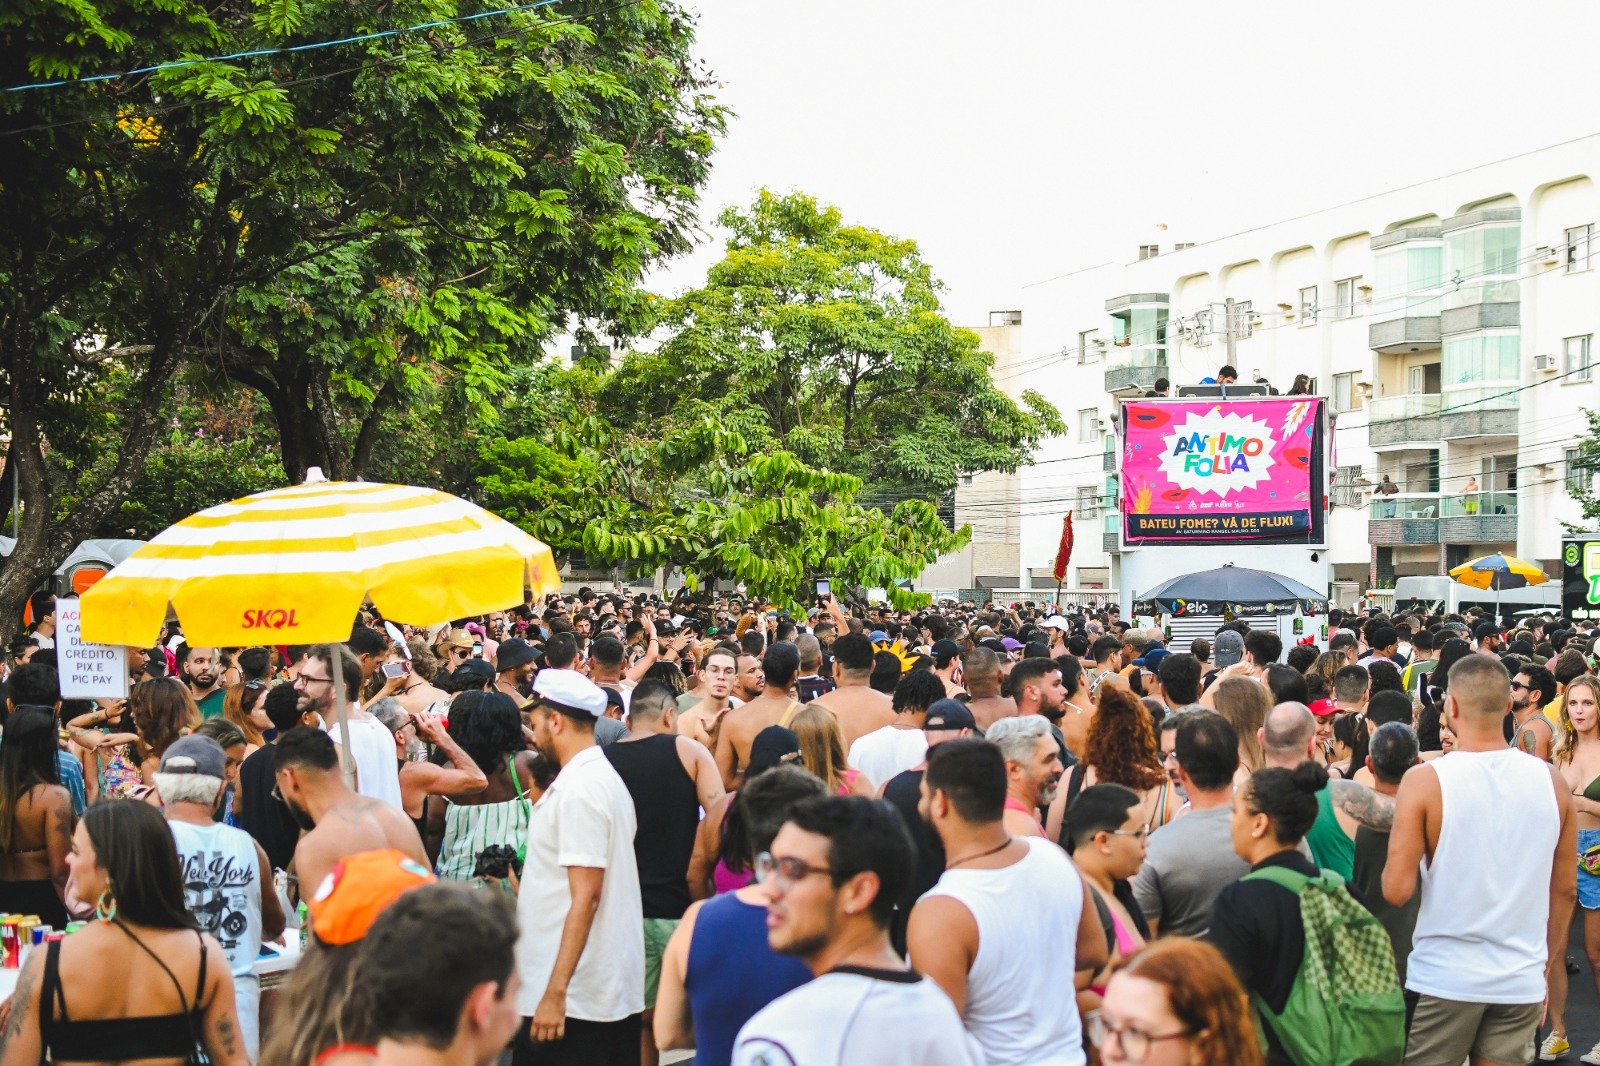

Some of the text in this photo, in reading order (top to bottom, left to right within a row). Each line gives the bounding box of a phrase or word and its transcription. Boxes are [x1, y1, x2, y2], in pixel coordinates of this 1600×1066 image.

[1173, 432, 1263, 457] ANTIMO
[1184, 454, 1250, 477] FOLIA
[1139, 519, 1176, 529] BATEU
[1180, 518, 1218, 529] FOME?
[1222, 516, 1238, 528] VÁ
[1241, 518, 1257, 528] DE
[241, 609, 299, 629] SKOL
[65, 648, 118, 660] CRÉDITO,
[76, 662, 103, 671] PIX E
[72, 675, 112, 684] PIC PAY
[208, 856, 254, 888] York
